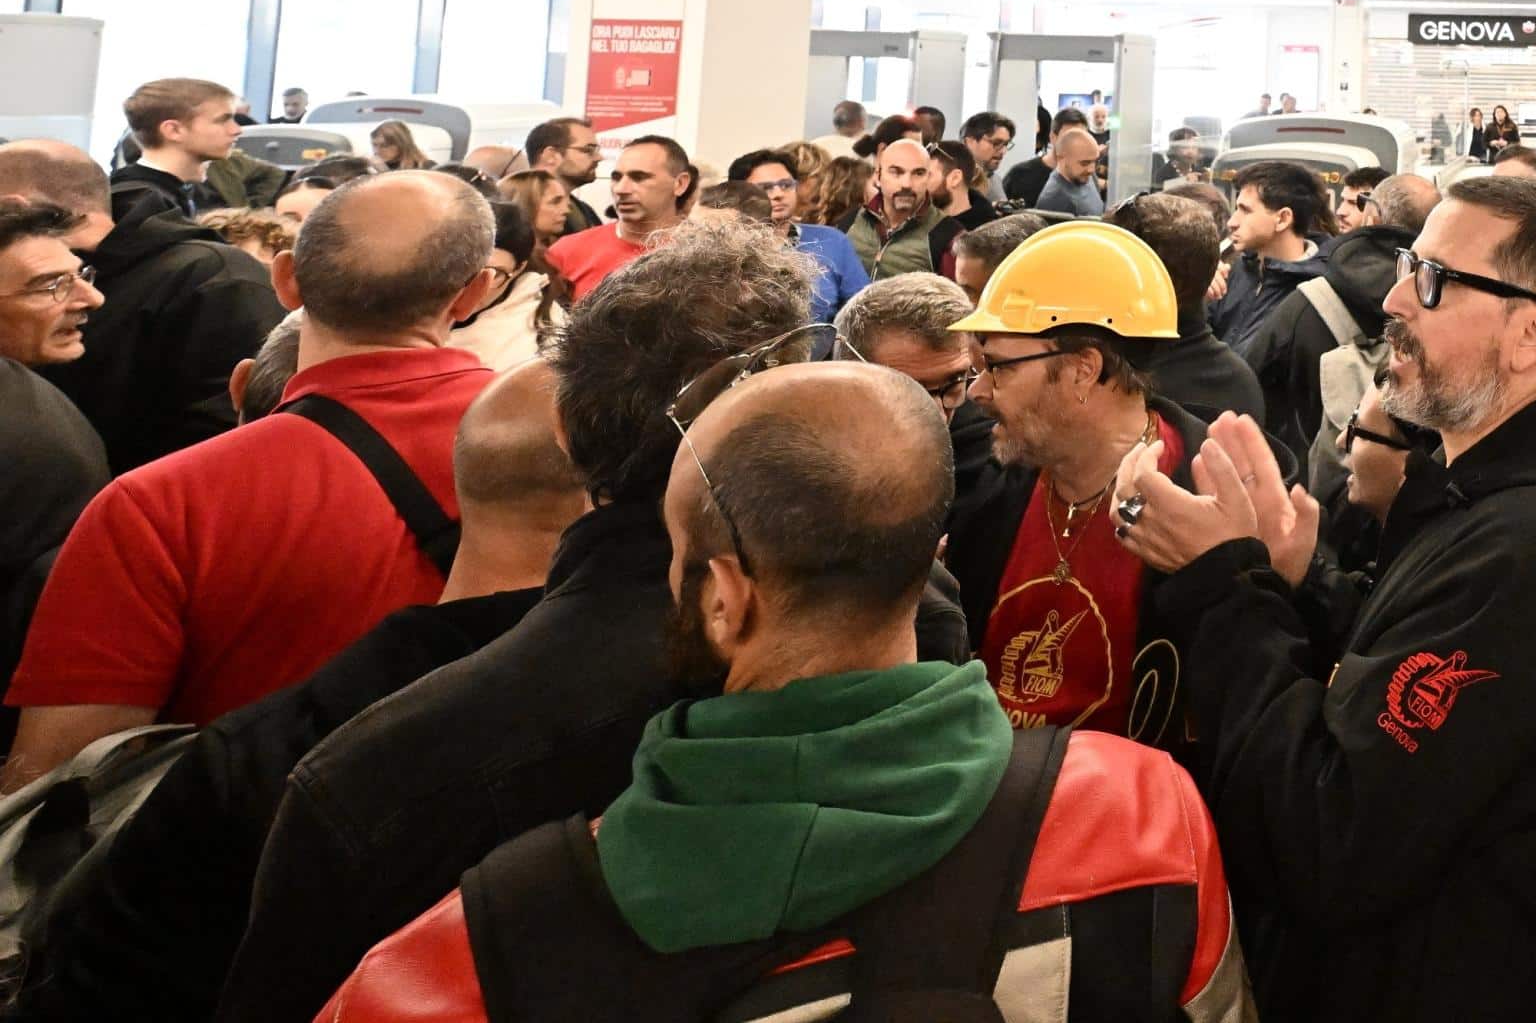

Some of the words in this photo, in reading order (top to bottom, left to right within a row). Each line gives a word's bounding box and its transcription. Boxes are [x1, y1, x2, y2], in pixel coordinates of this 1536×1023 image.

[1419, 20, 1515, 42] GENOVA
[1024, 675, 1058, 696] FIOM
[1007, 707, 1047, 729] OVA
[1411, 696, 1442, 727] FIOM
[1376, 712, 1419, 753] Genova
